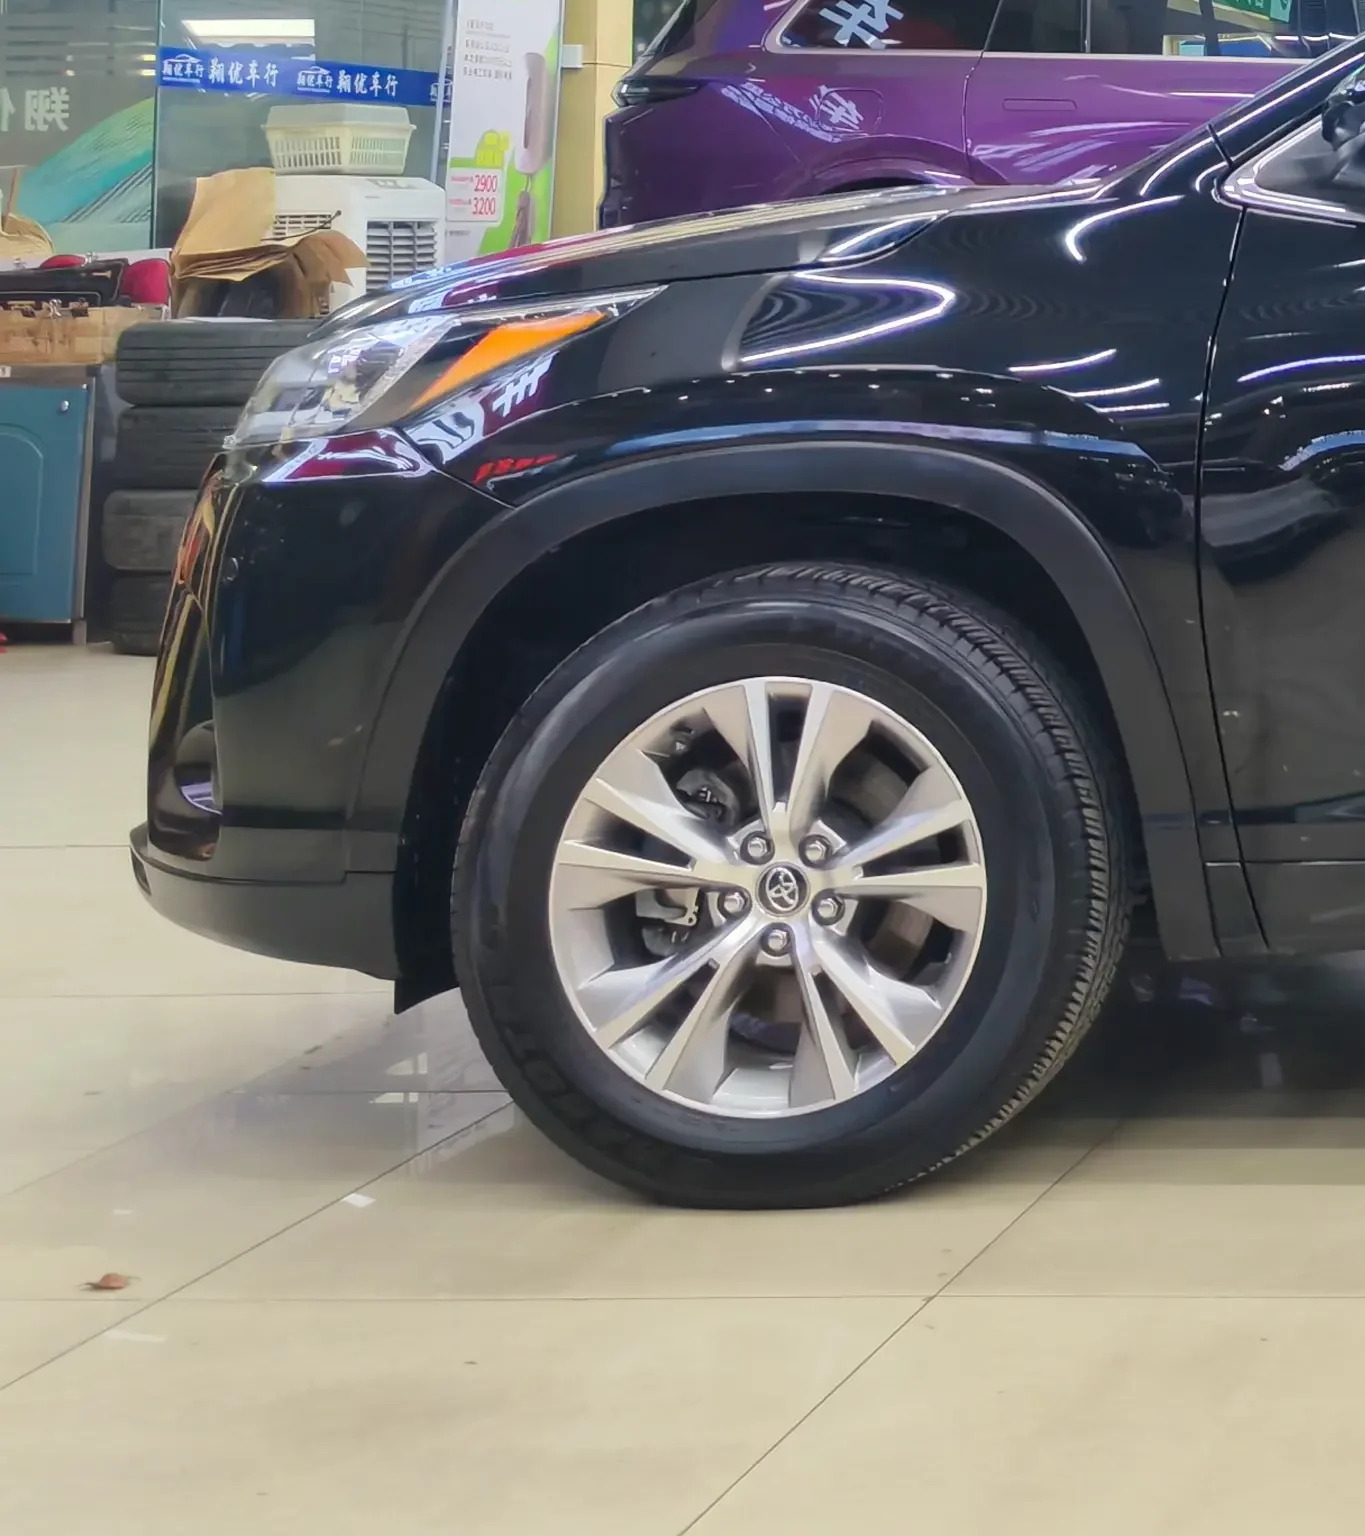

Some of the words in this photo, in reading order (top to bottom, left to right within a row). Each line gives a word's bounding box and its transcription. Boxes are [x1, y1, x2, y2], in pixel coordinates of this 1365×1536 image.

[208, 56, 280, 88] 翔优车行
[337, 68, 399, 99] 翔优车行
[474, 174, 498, 193] 2900
[472, 197, 496, 215] 3200
